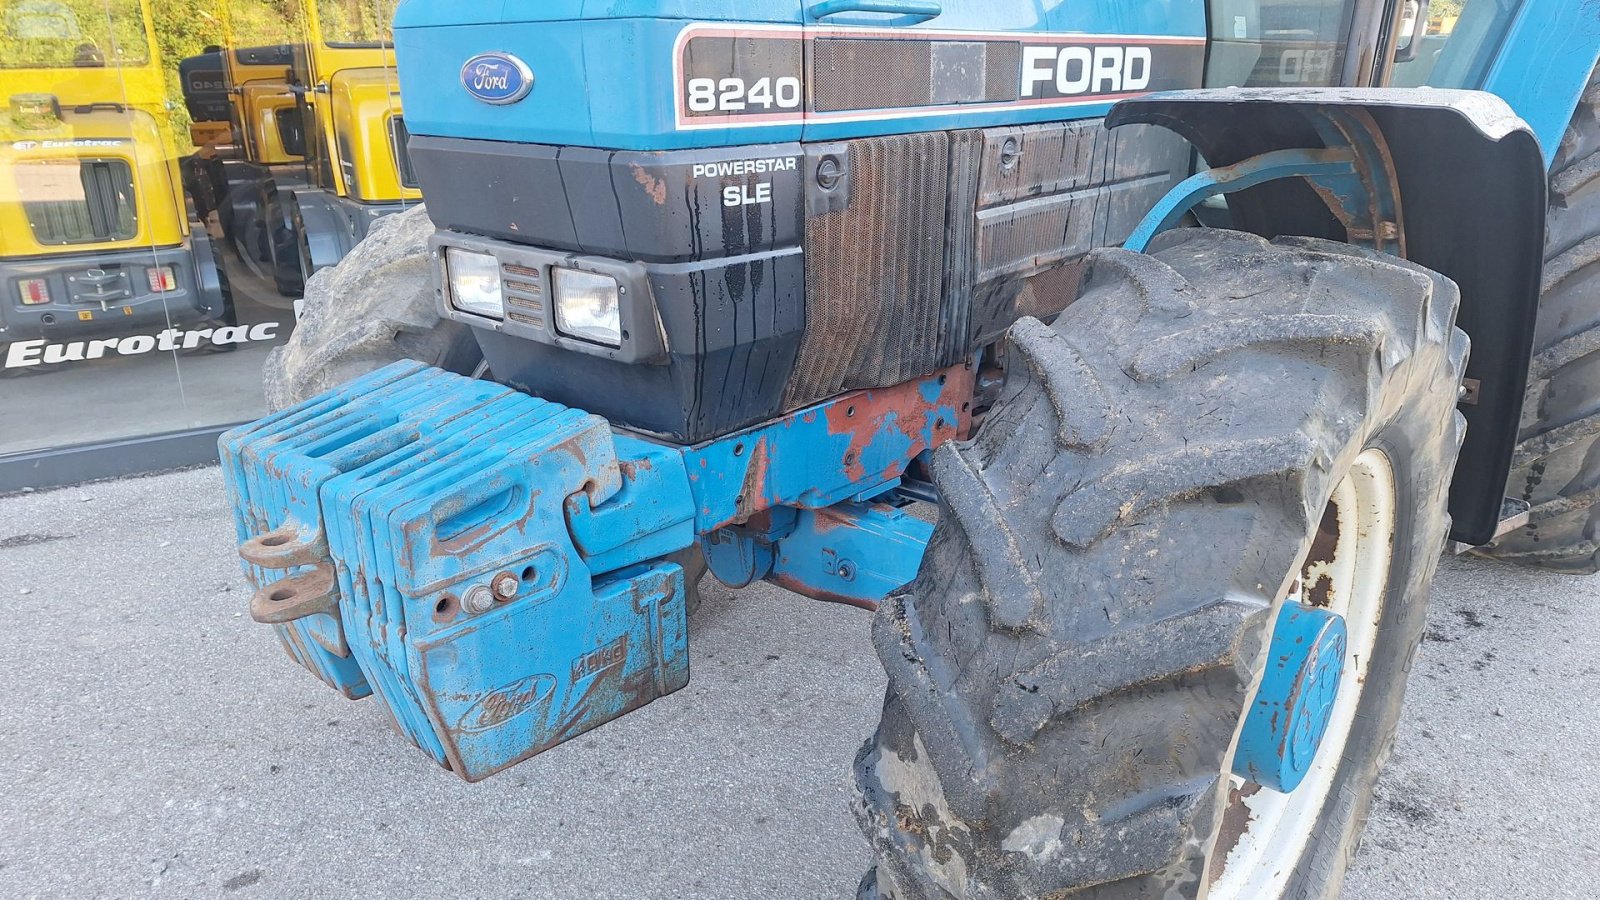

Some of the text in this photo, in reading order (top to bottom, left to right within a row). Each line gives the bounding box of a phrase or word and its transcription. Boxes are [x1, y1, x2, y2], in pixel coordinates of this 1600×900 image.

[473, 63, 510, 91] Ford
[1021, 46, 1152, 97] FORD
[688, 76, 800, 112] 8240
[42, 139, 122, 149] Eurotrac
[693, 157, 797, 179] POWERSTAR
[723, 183, 771, 207] SLE
[5, 322, 279, 368] Eurotrac
[481, 683, 536, 722] Ford
